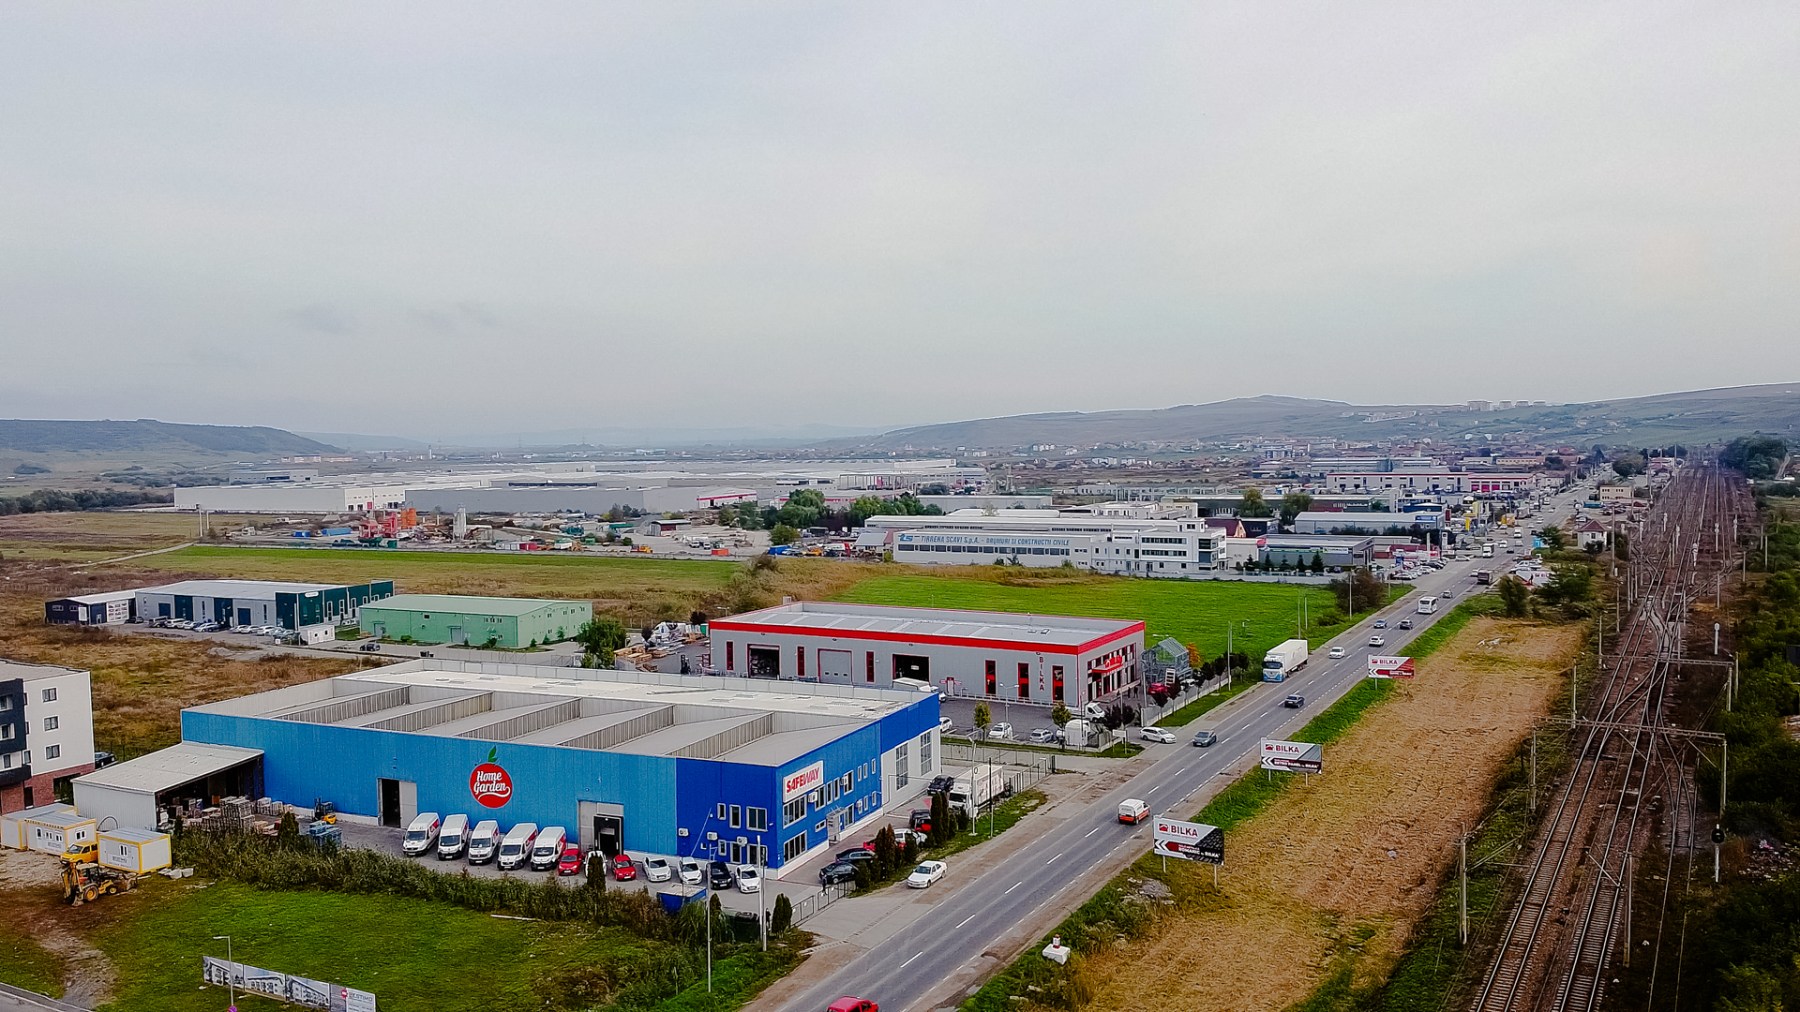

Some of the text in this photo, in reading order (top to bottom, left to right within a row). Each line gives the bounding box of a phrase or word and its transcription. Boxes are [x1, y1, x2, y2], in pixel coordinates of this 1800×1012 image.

[946, 536, 963, 544] SCAVI
[1276, 744, 1300, 754] BILKA
[477, 770, 503, 781] Home
[786, 767, 820, 793] SAFEWAY
[473, 781, 508, 796] Garden
[1171, 825, 1198, 837] BILKA
